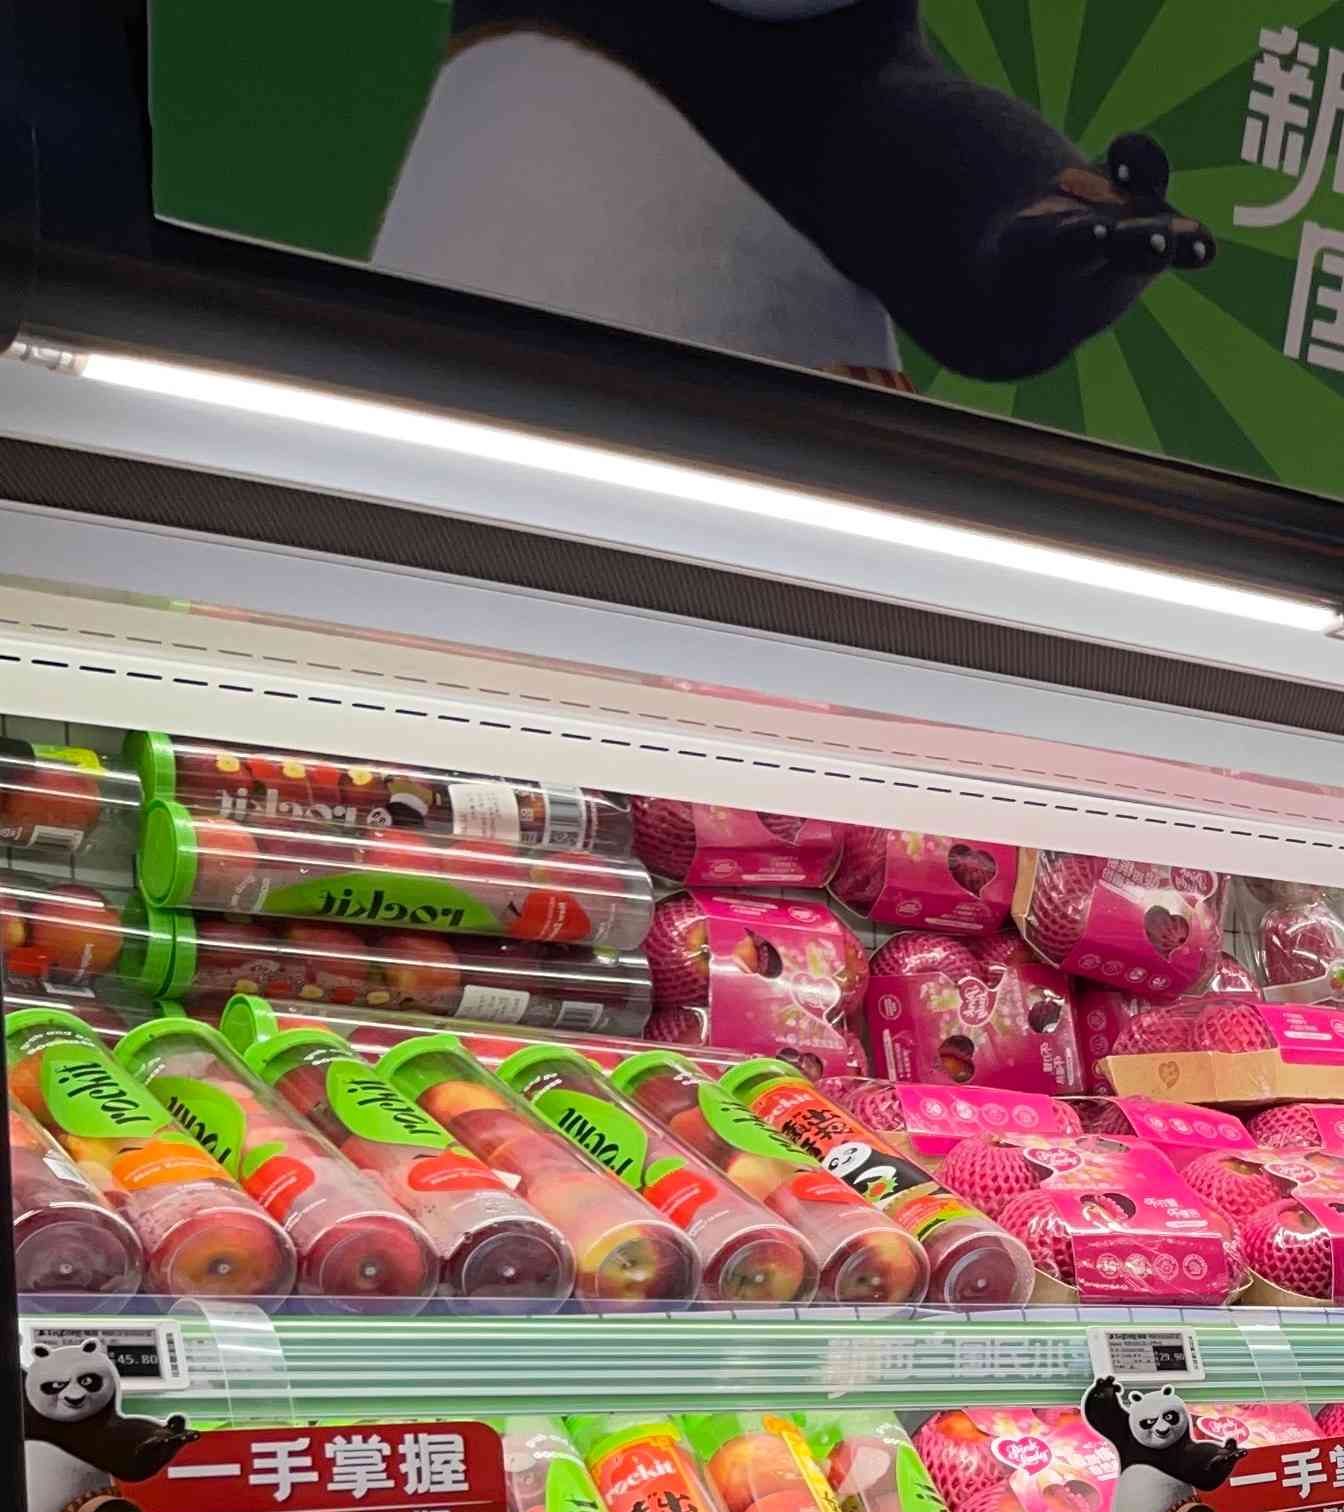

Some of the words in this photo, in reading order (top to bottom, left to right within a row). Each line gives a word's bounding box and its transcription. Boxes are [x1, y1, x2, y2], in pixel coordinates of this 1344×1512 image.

[117, 1353, 159, 1365] 45.80
[167, 1433, 470, 1502] 一手掌握
[605, 1456, 677, 1505] rockit
